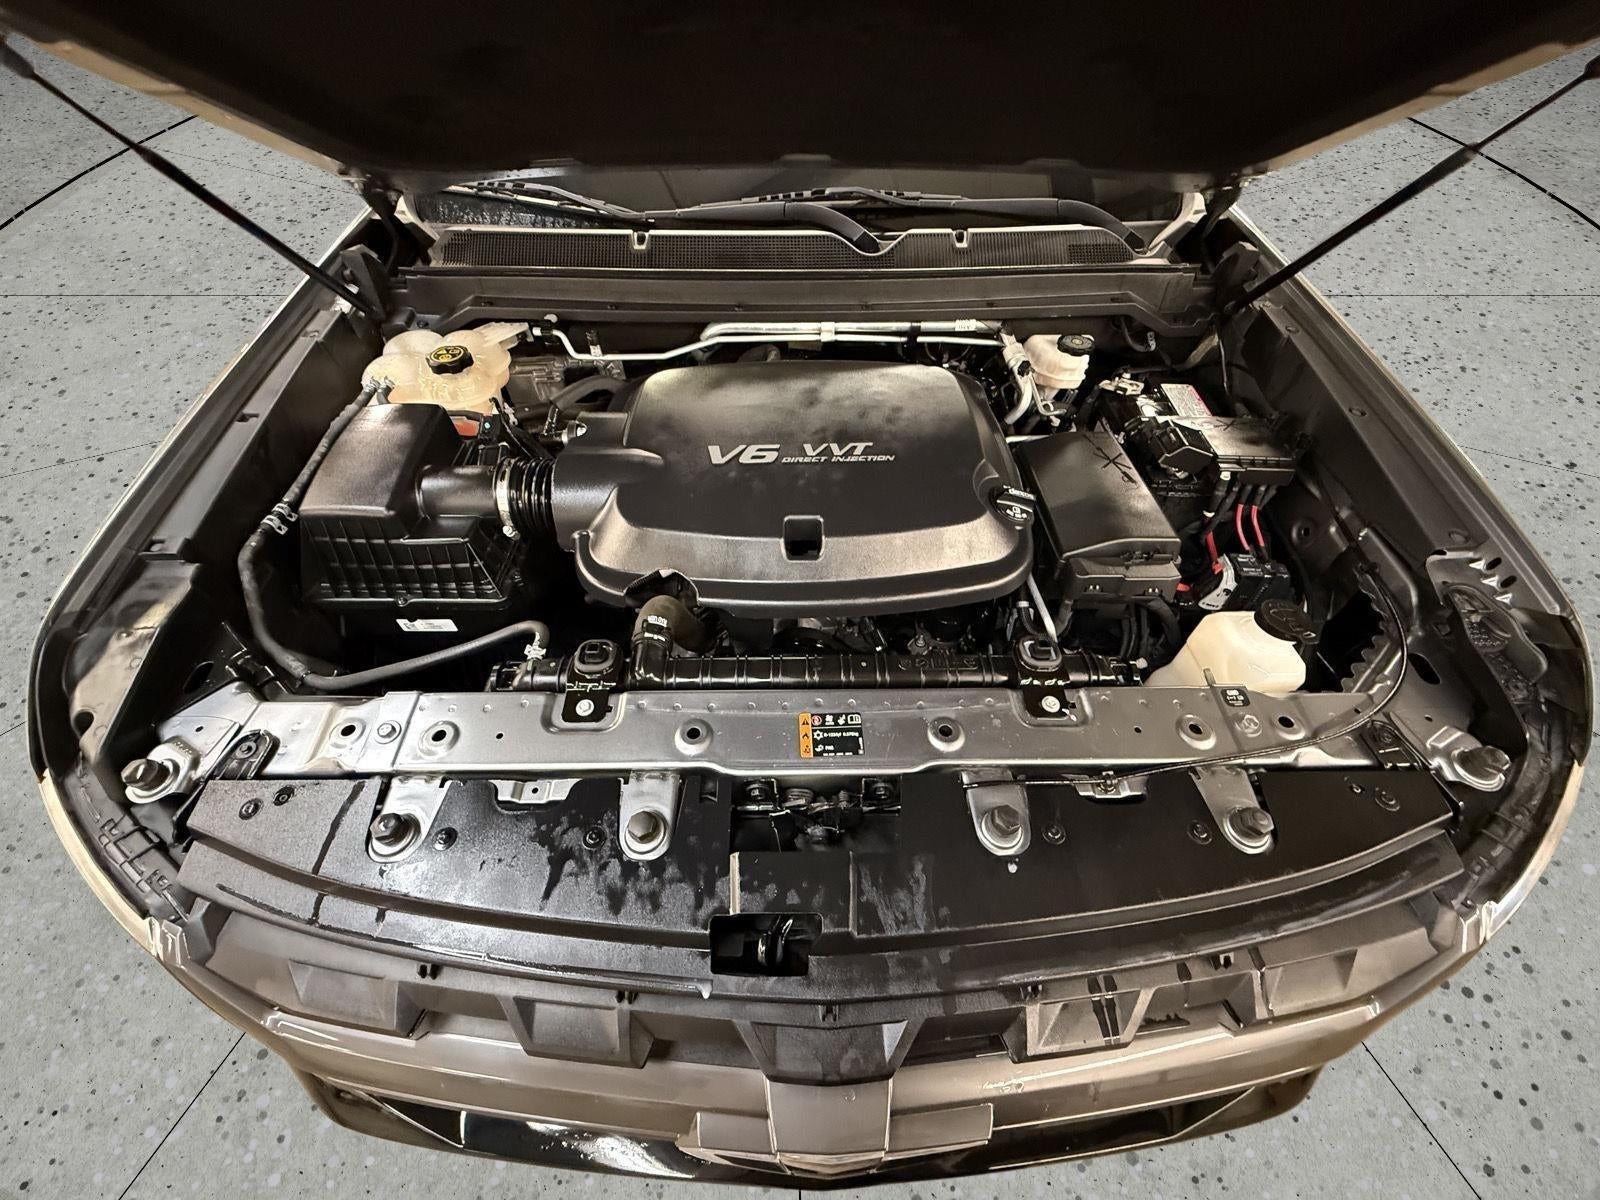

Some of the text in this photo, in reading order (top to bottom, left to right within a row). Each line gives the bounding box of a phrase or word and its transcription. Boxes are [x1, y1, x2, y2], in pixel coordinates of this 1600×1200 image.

[708, 442, 873, 464] V6 VVT
[831, 454, 895, 463] INJECTION
